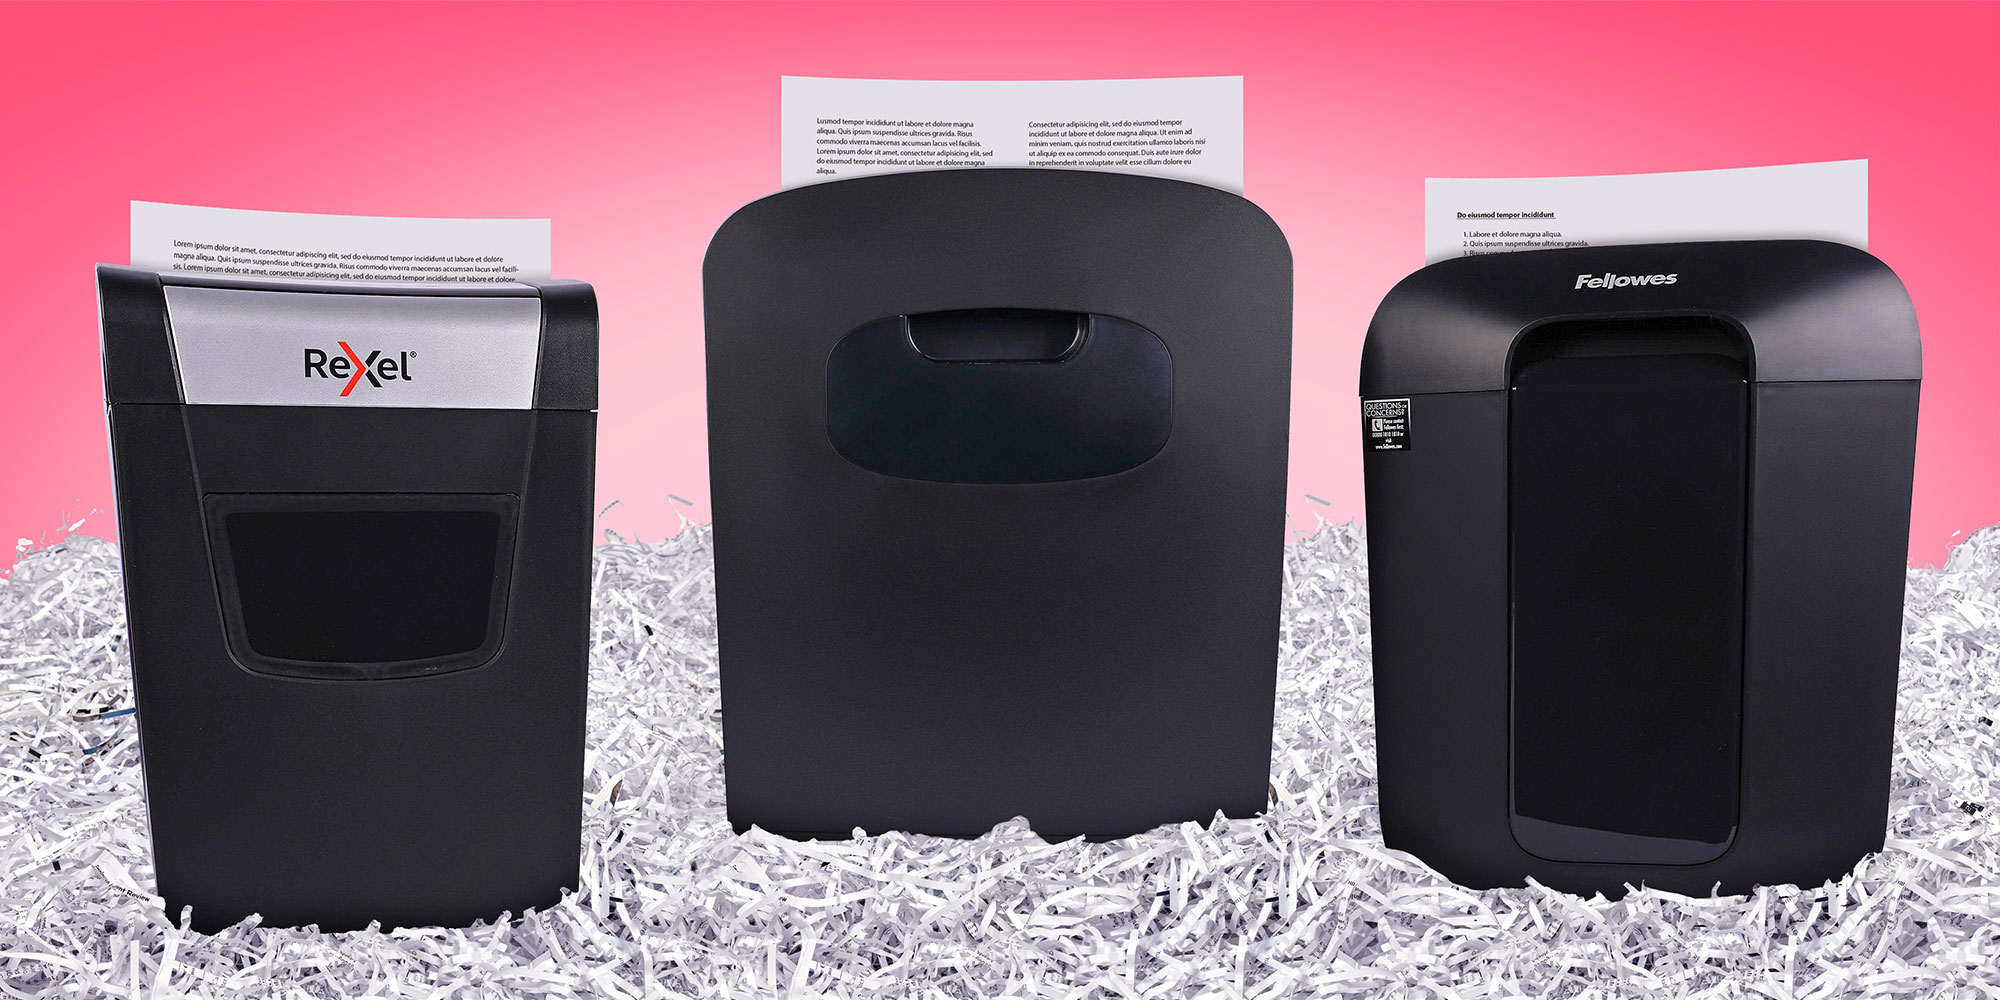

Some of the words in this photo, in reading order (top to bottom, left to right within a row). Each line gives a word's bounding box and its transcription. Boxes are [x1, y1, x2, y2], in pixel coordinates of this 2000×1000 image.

[842, 119, 864, 127] tempor
[1160, 119, 1182, 128] tempor
[852, 128, 872, 137] ipsum
[872, 128, 908, 138] suspendisse
[1074, 139, 1087, 149] quis
[837, 147, 856, 157] ipsum
[1036, 149, 1058, 159] aliquip
[853, 158, 876, 167] tempor
[1496, 212, 1521, 220] tempor
[174, 239, 193, 248] Lorem
[194, 241, 213, 252] ipsum
[214, 243, 231, 252] dolor
[259, 248, 295, 257] consectetur
[341, 252, 352, 260] sed
[362, 253, 389, 261] eiusmod
[390, 255, 413, 264] tempor
[414, 254, 446, 262] incididunt
[173, 253, 195, 262] magna
[217, 254, 232, 263] Quis
[232, 255, 252, 266] ipsum
[252, 257, 290, 268] suspendisse
[290, 259, 313, 267] ultrices
[339, 262, 355, 270] Risus
[356, 262, 388, 271] commodo
[388, 263, 410, 271] viverra
[1575, 272, 1678, 289] Fellowes
[126, 890, 150, 902] Review
